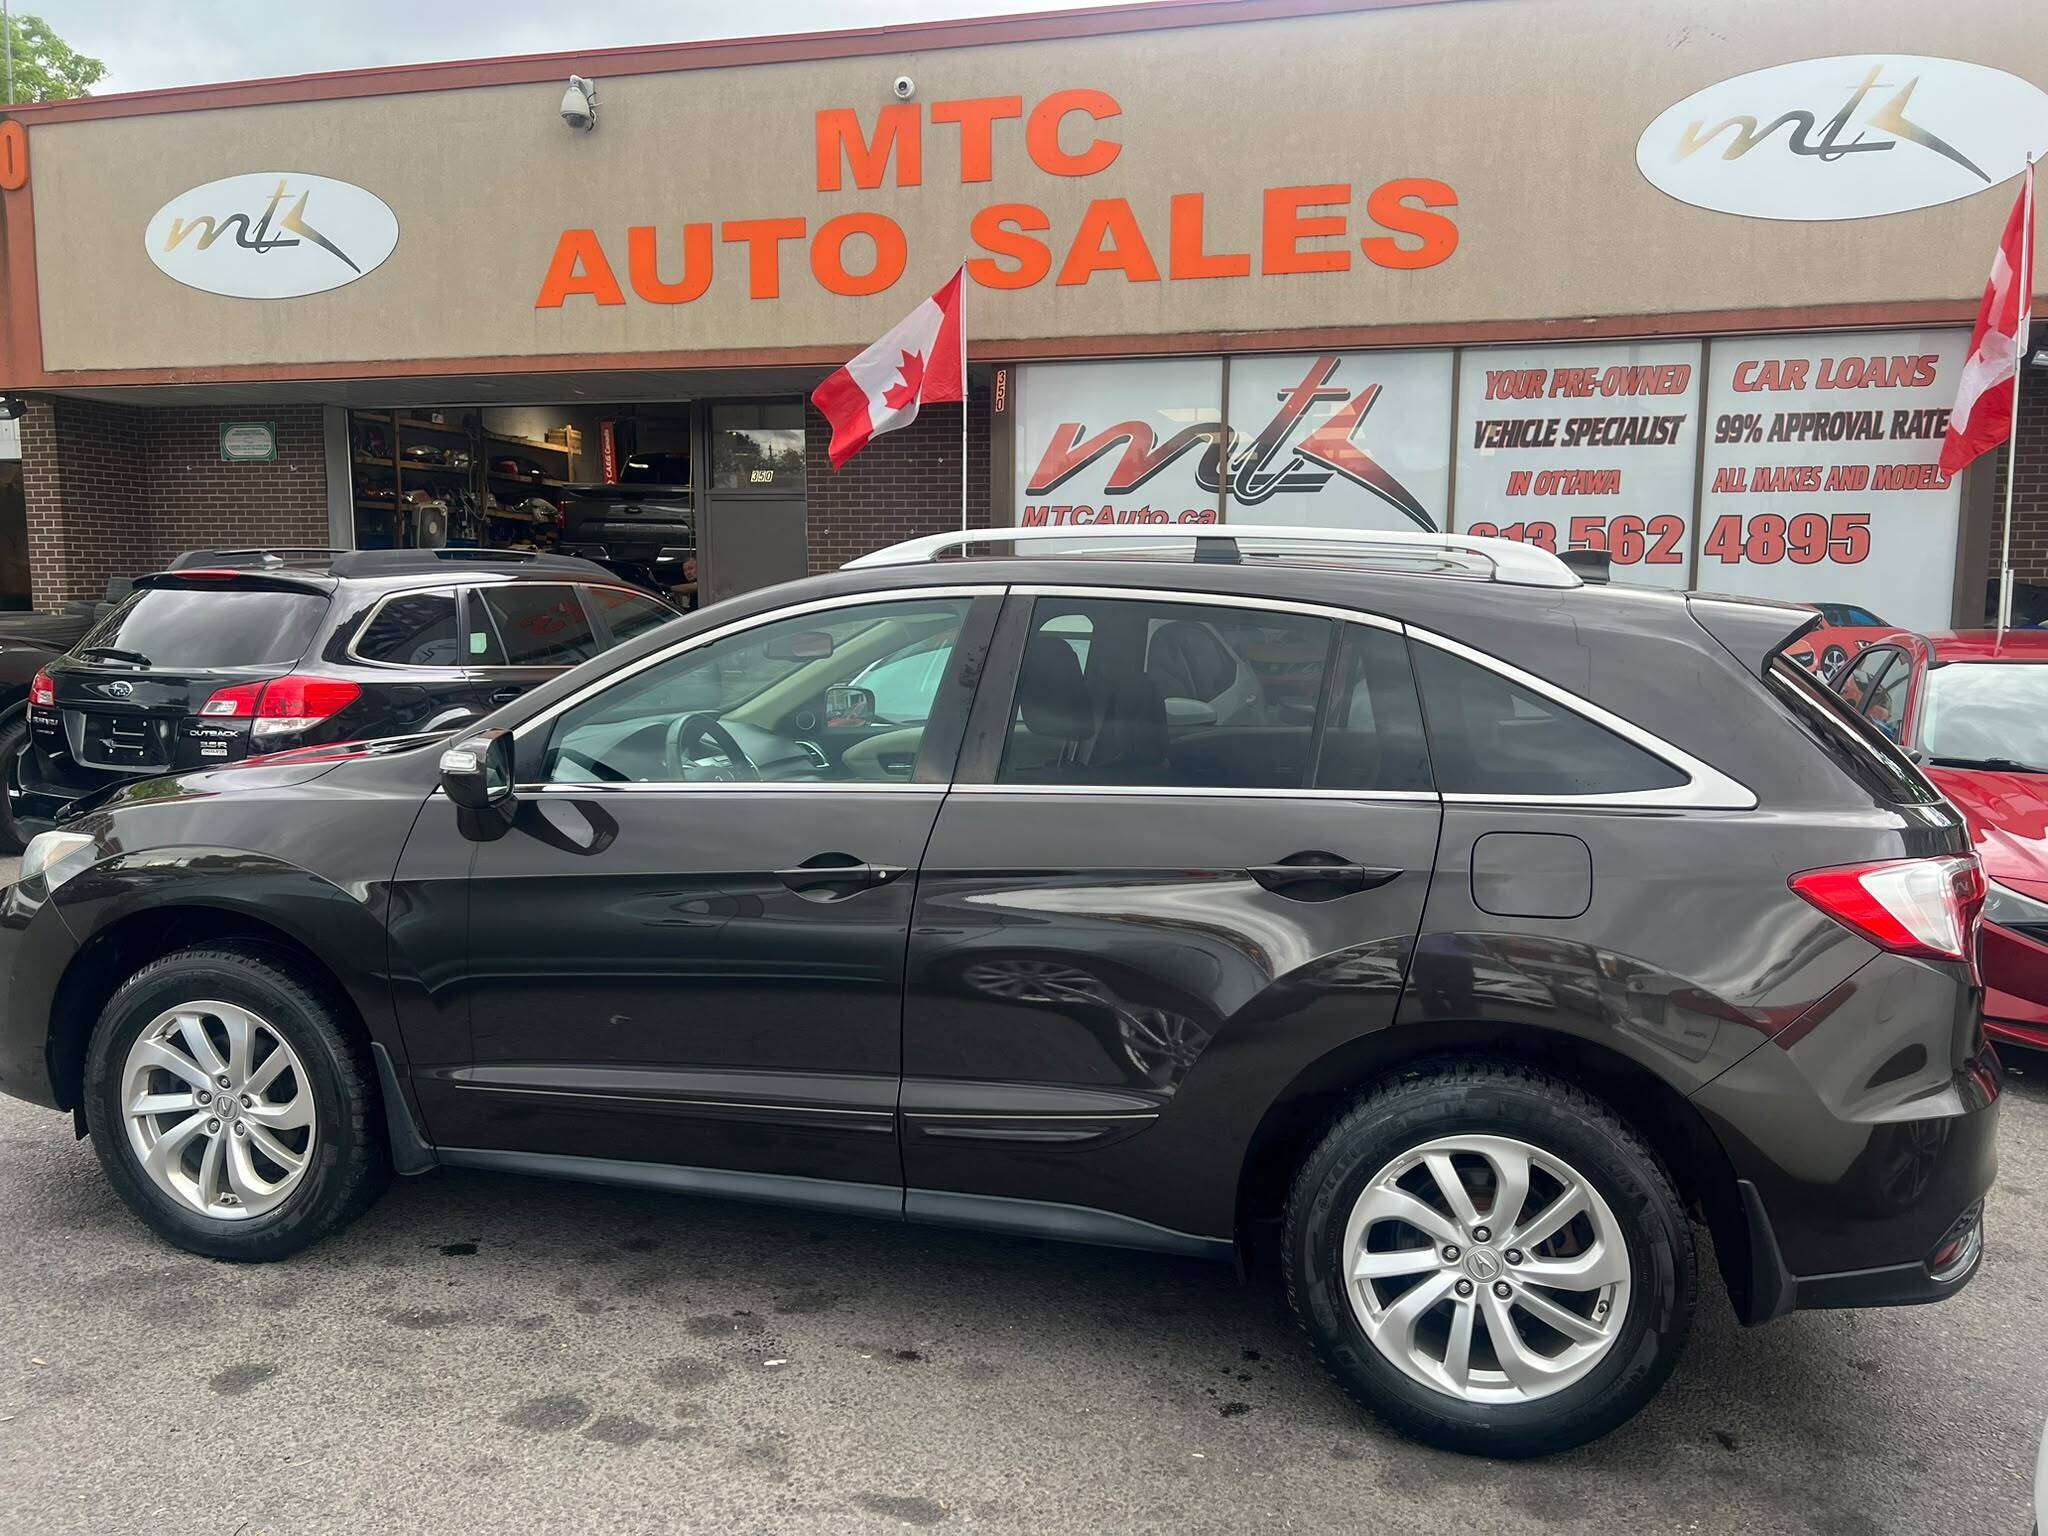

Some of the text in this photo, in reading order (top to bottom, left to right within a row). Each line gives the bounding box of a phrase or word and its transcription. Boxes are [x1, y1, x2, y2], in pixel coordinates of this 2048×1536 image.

[816, 89, 1122, 192] MTC
[535, 178, 1459, 309] AUTO SALES
[995, 370, 1007, 412] 350
[1485, 364, 1692, 400] YOUR PRE-OWNED
[1732, 355, 1939, 392] CAR LOANS
[1473, 414, 1687, 449] VEHICLE SPECIALIST
[1714, 408, 1952, 443] 99% APPROVAL RATE
[751, 471, 773, 482] 350
[1505, 469, 1621, 496] IN OTTAWA
[1712, 463, 1951, 493] ALL MAKES AND MODELS
[1021, 504, 1217, 528] MTCAutoca
[1568, 515, 1686, 565] 562
[1704, 513, 1871, 565] 4895
[189, 729, 239, 738] OUTBACK
